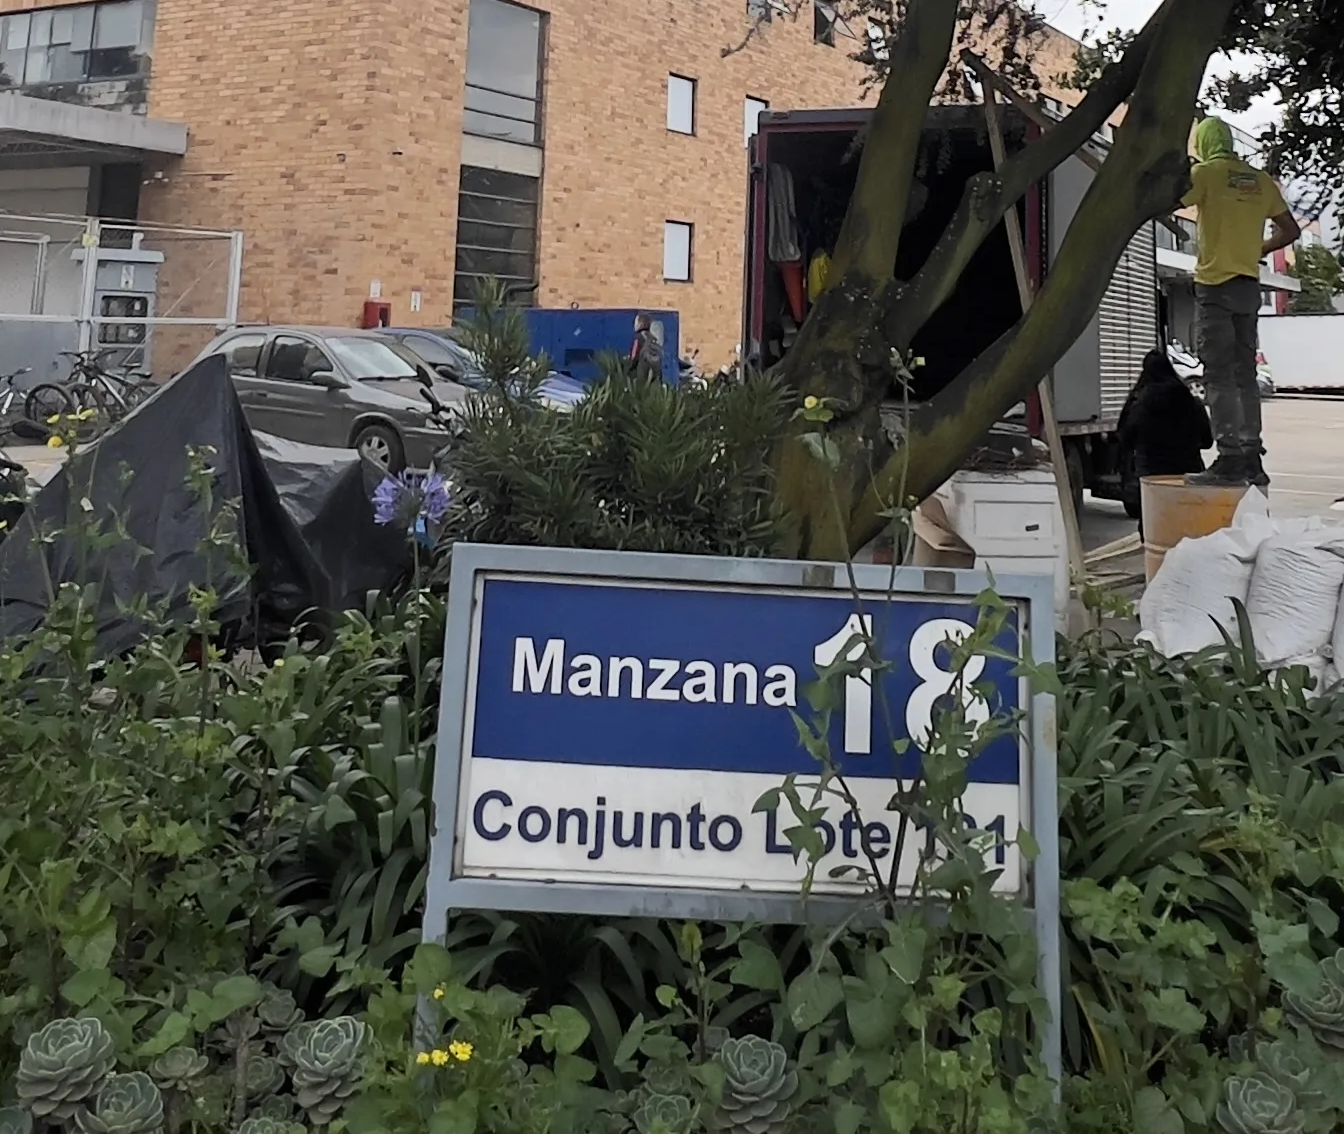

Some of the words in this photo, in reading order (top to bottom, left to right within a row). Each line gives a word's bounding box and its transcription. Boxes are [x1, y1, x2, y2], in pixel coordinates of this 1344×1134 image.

[512, 636, 797, 706] Manzana
[813, 612, 991, 757] 18
[472, 789, 743, 860] Conjunto
